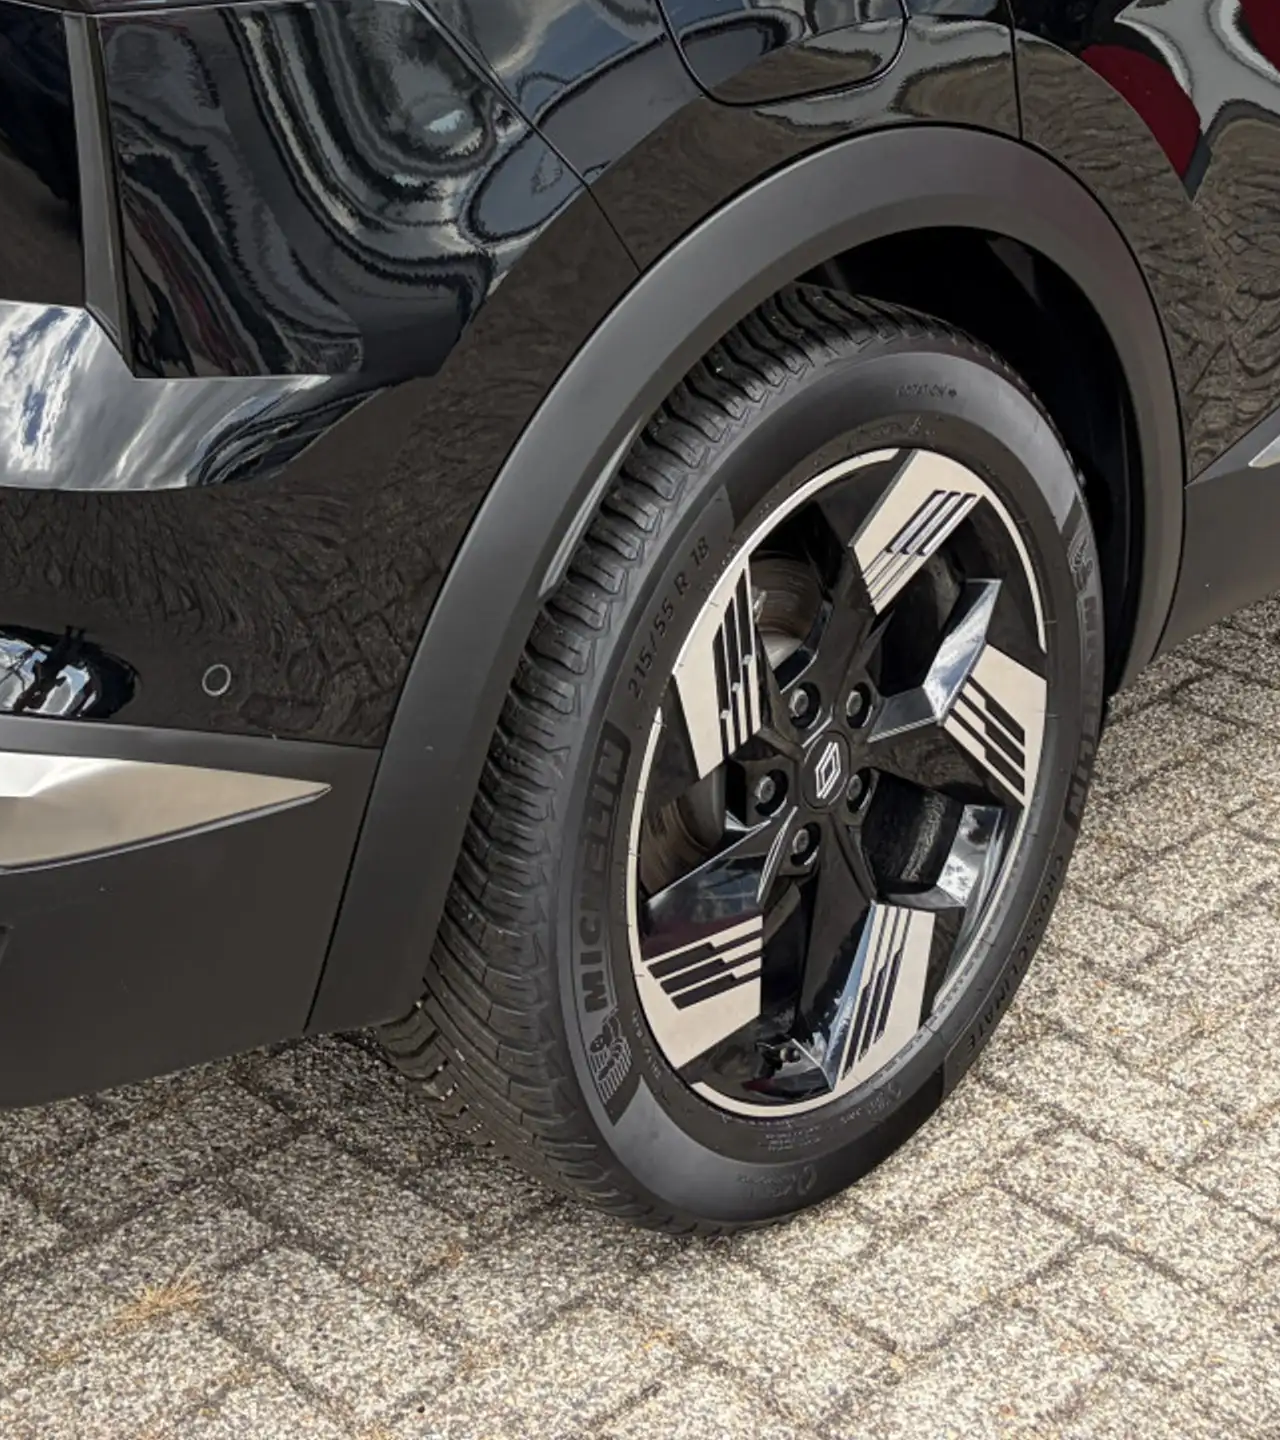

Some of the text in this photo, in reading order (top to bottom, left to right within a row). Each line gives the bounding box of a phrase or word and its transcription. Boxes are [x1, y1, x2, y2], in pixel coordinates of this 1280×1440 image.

[628, 536, 710, 700] 215/55 R 18
[578, 736, 628, 1014] MICHELIN
